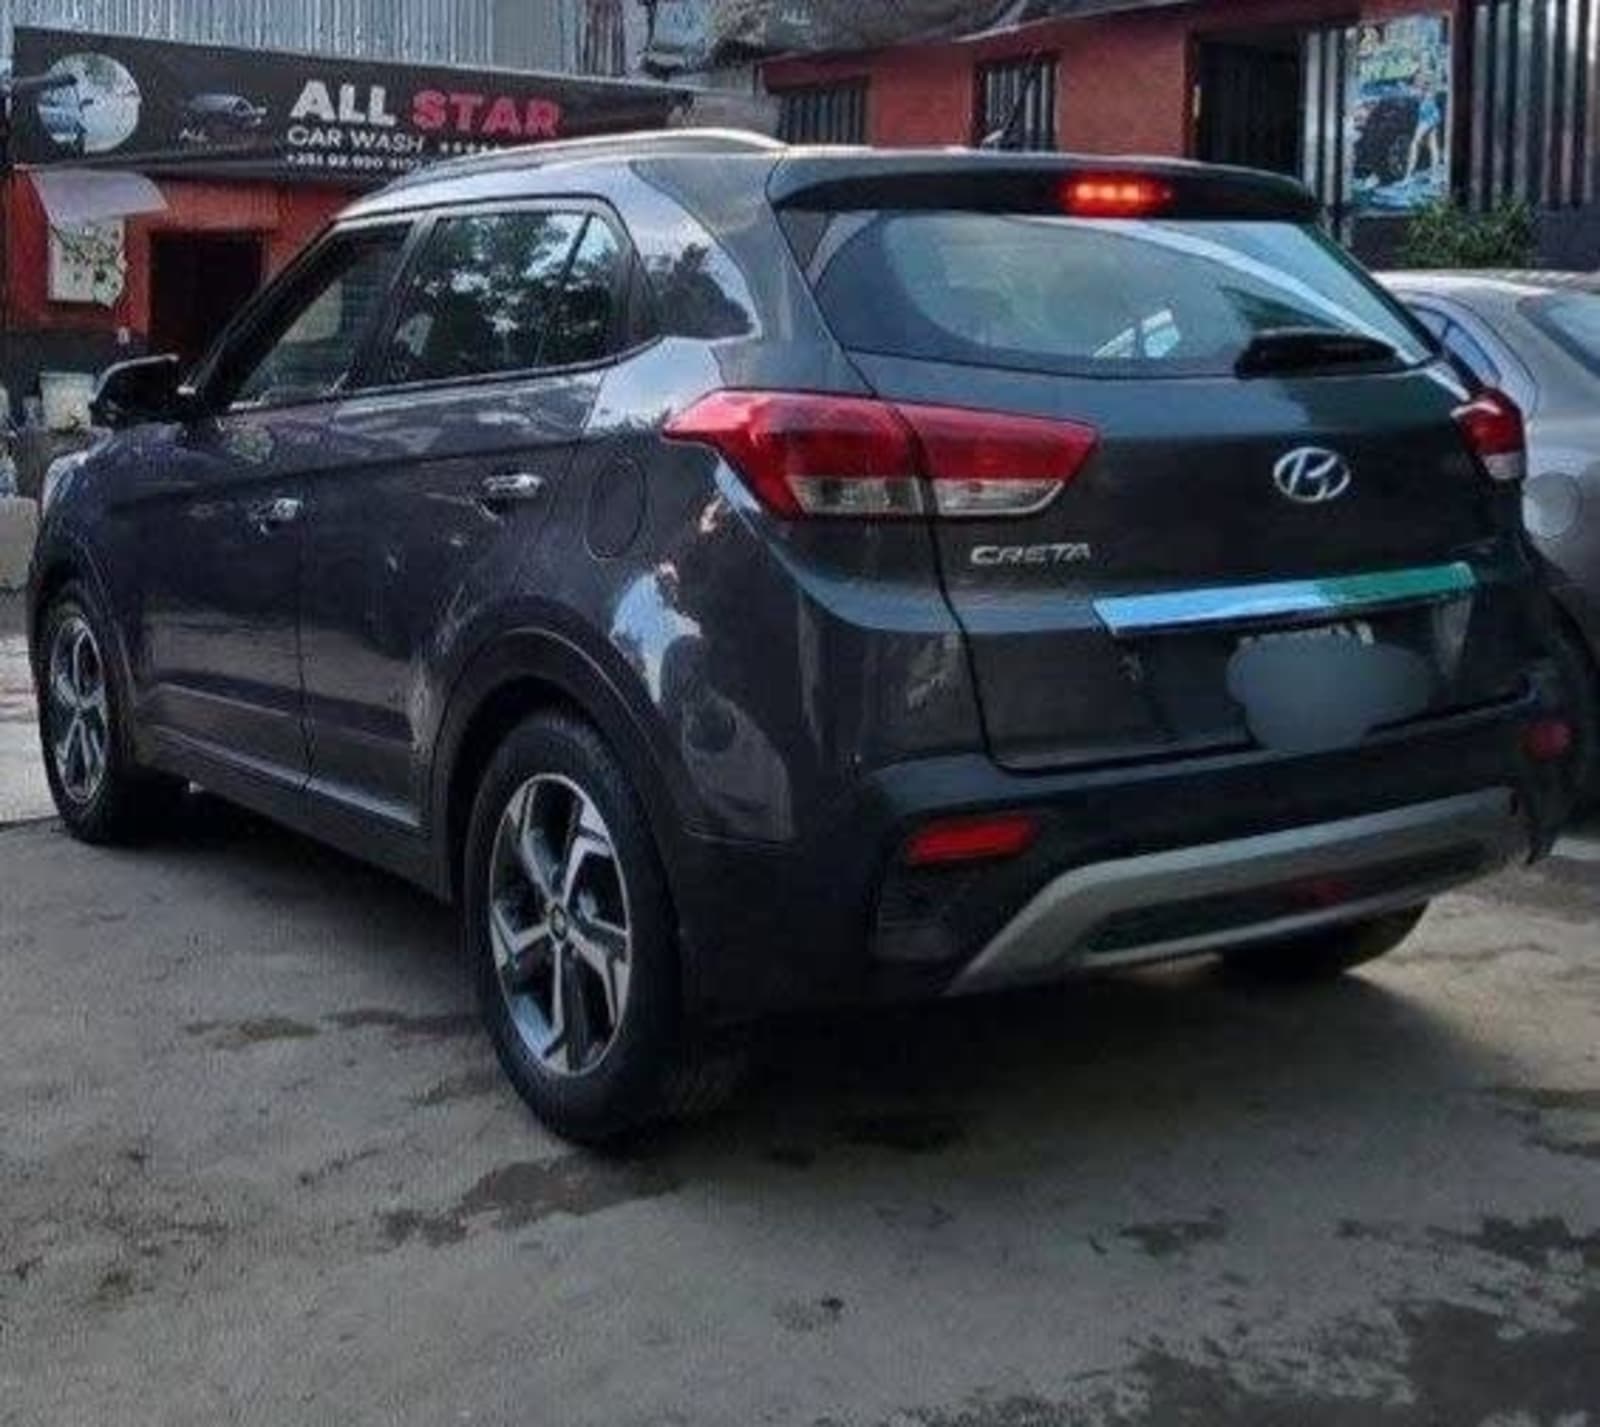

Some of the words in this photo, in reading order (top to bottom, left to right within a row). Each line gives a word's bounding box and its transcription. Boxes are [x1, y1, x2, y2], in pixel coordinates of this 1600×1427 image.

[290, 79, 396, 127] ALL
[412, 89, 562, 137] STAR
[287, 125, 342, 148] CAR
[350, 130, 425, 153] WASH
[970, 543, 1091, 565] CRETA
